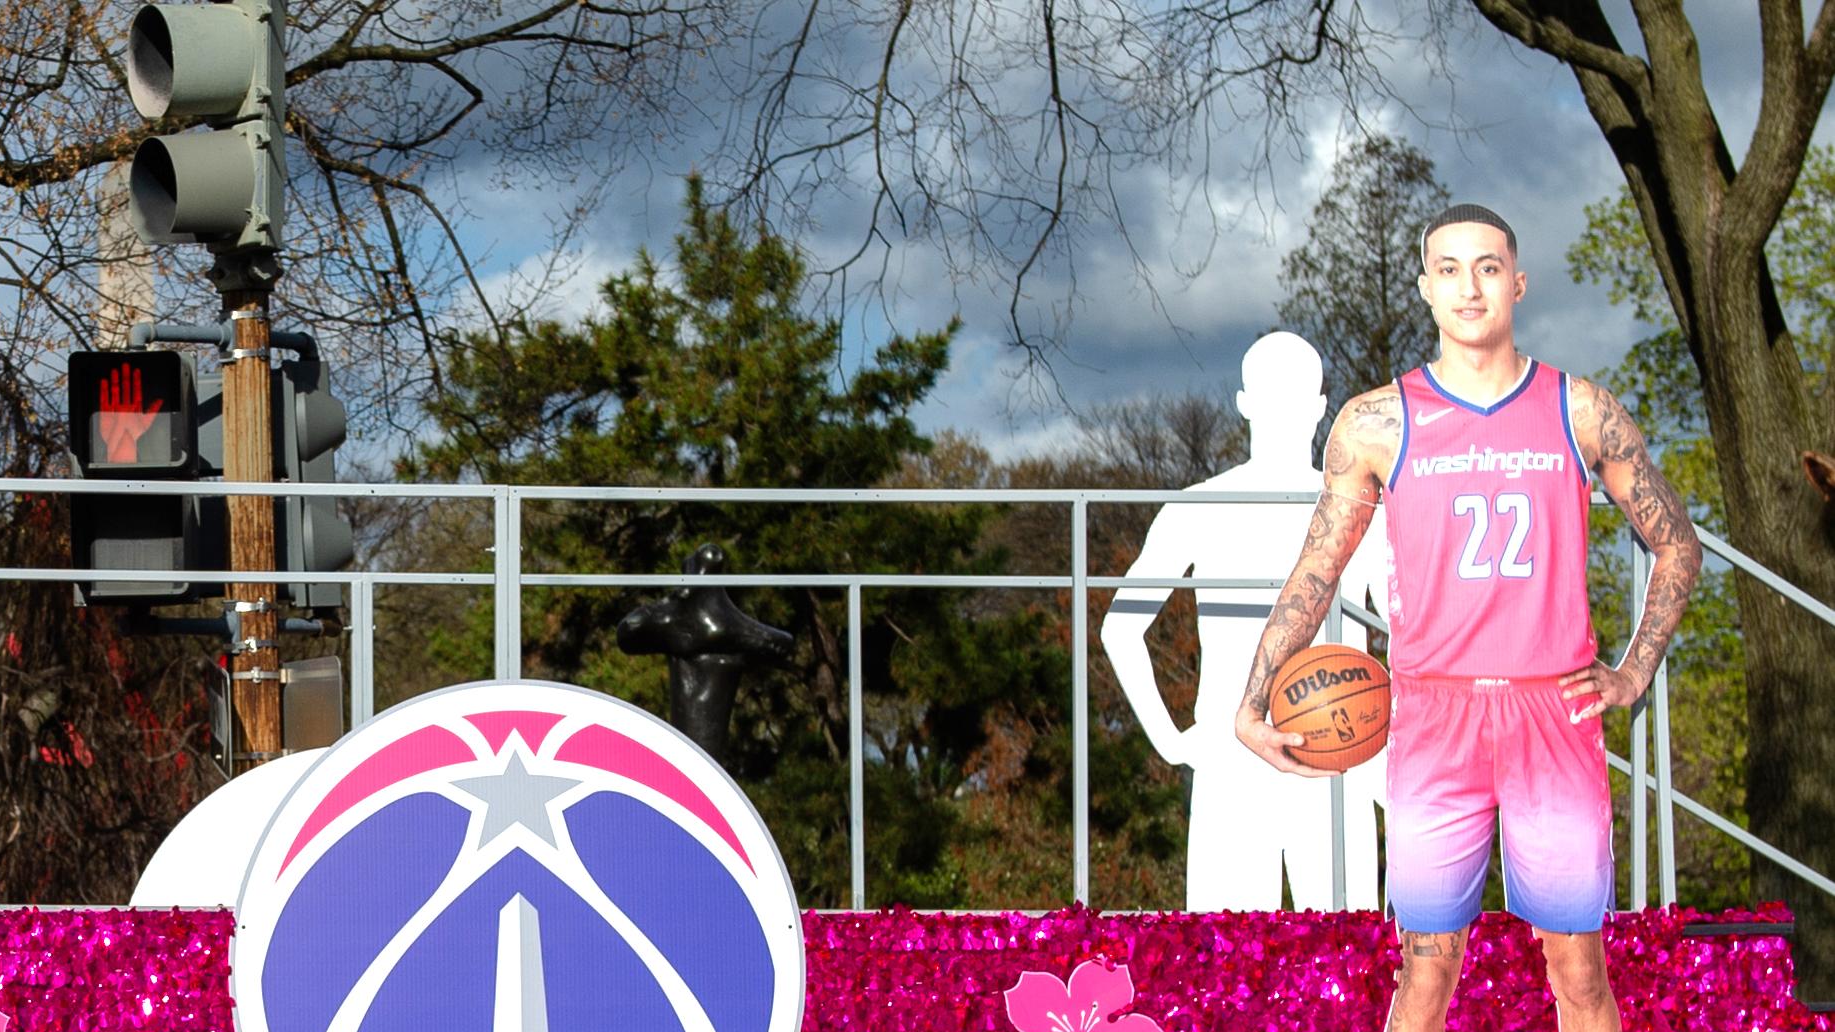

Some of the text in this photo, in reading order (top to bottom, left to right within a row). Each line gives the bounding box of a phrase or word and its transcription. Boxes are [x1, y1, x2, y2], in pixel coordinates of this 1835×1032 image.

[1412, 443, 1565, 479] washington
[1452, 492, 1535, 580] 22
[1284, 667, 1372, 706] Wilson
